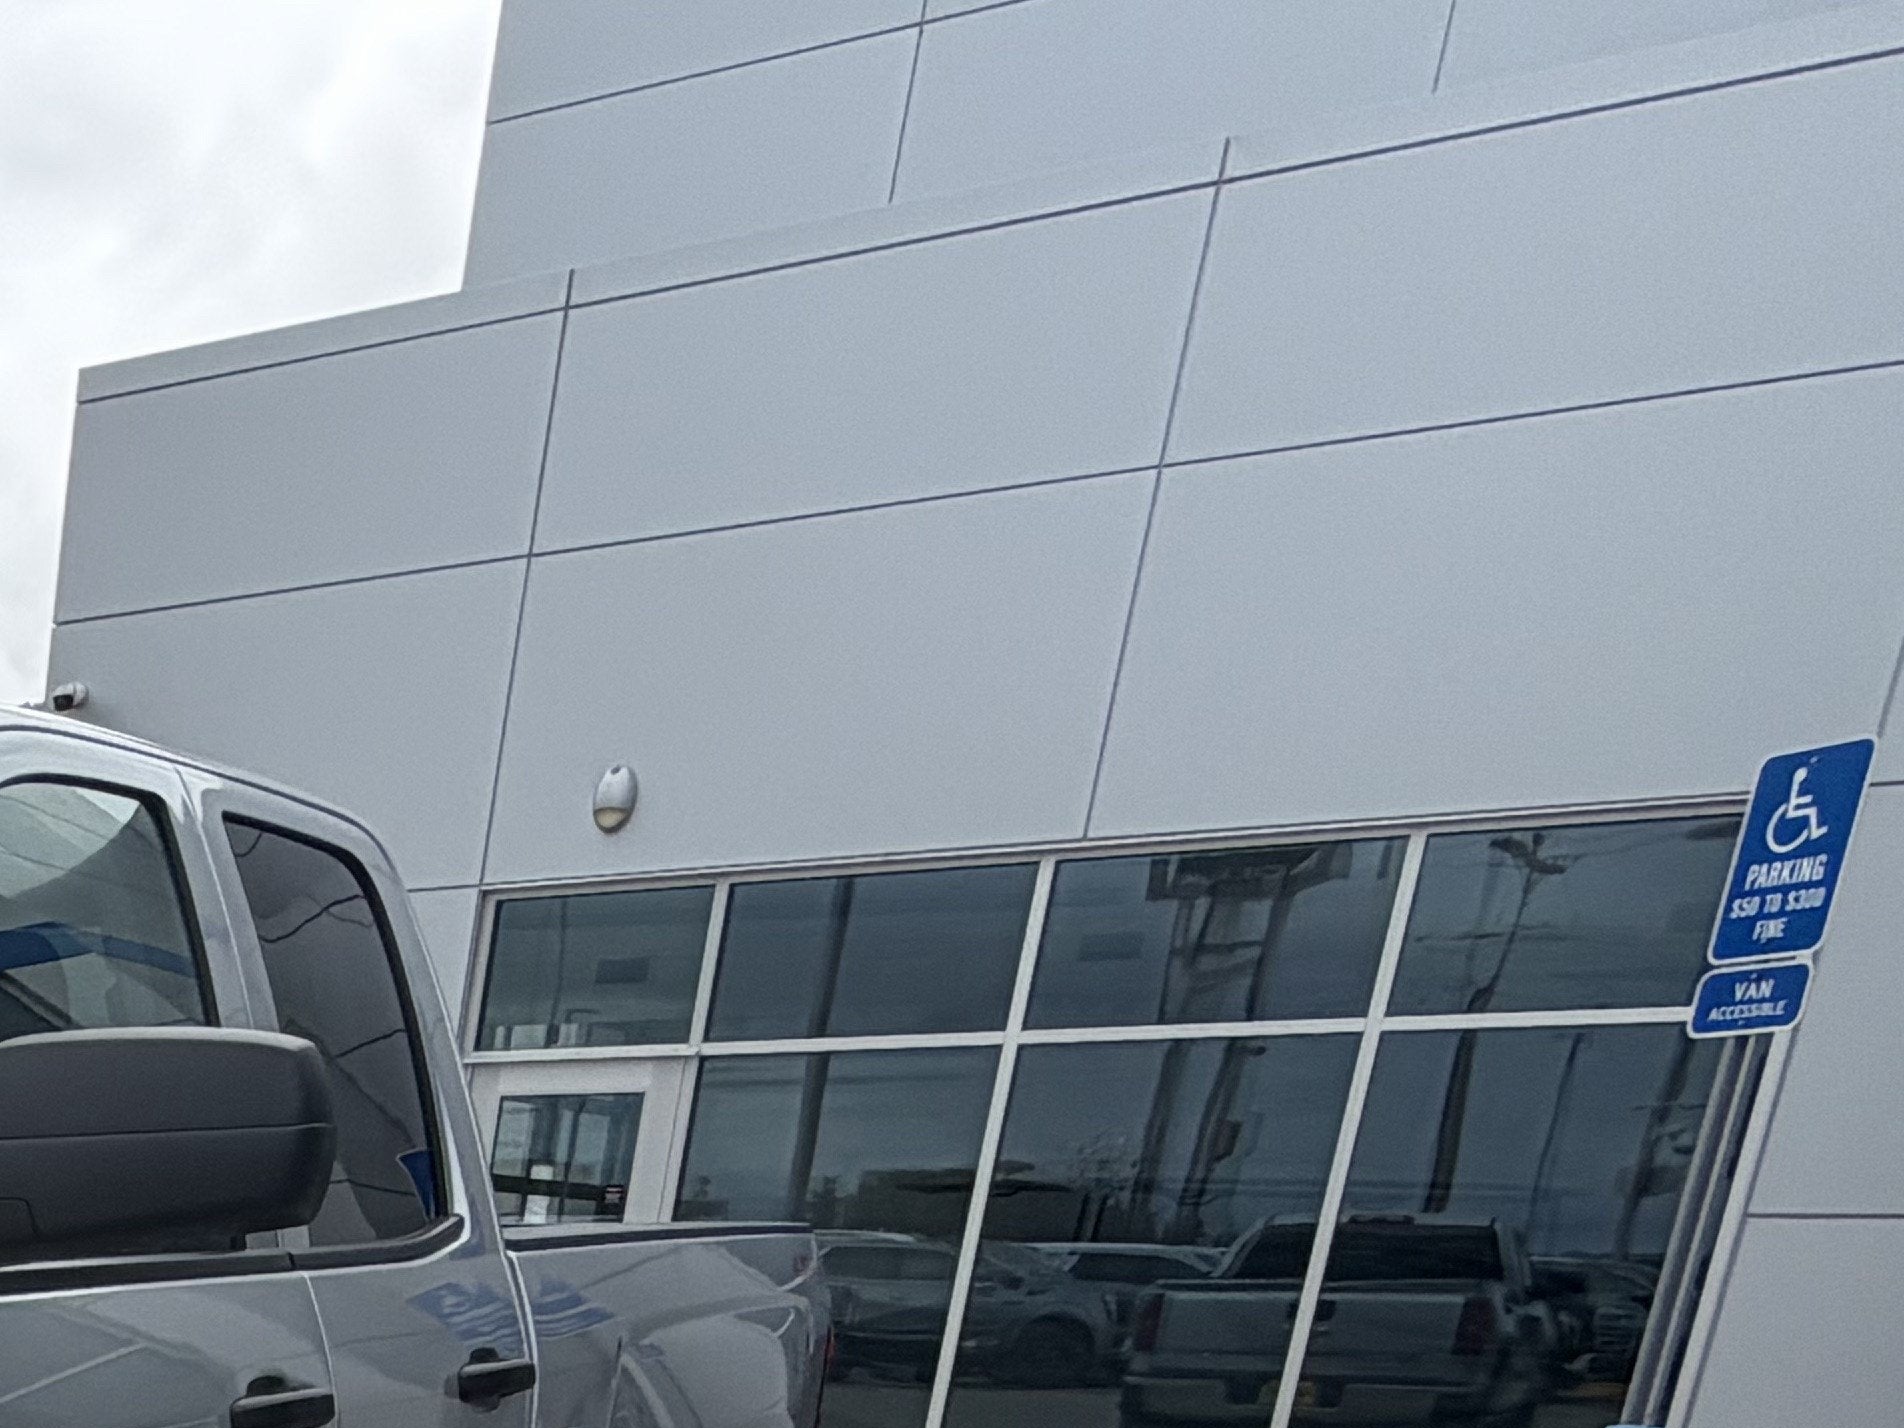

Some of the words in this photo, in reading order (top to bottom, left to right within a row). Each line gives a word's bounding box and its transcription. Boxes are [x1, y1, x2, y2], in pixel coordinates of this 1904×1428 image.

[1744, 854, 1827, 891] PARKING
[1763, 892, 1783, 914] TO
[1752, 917, 1788, 943] FINE
[1734, 978, 1775, 1001] VAN
[1707, 1000, 1787, 1020] ACCESSIBLE
